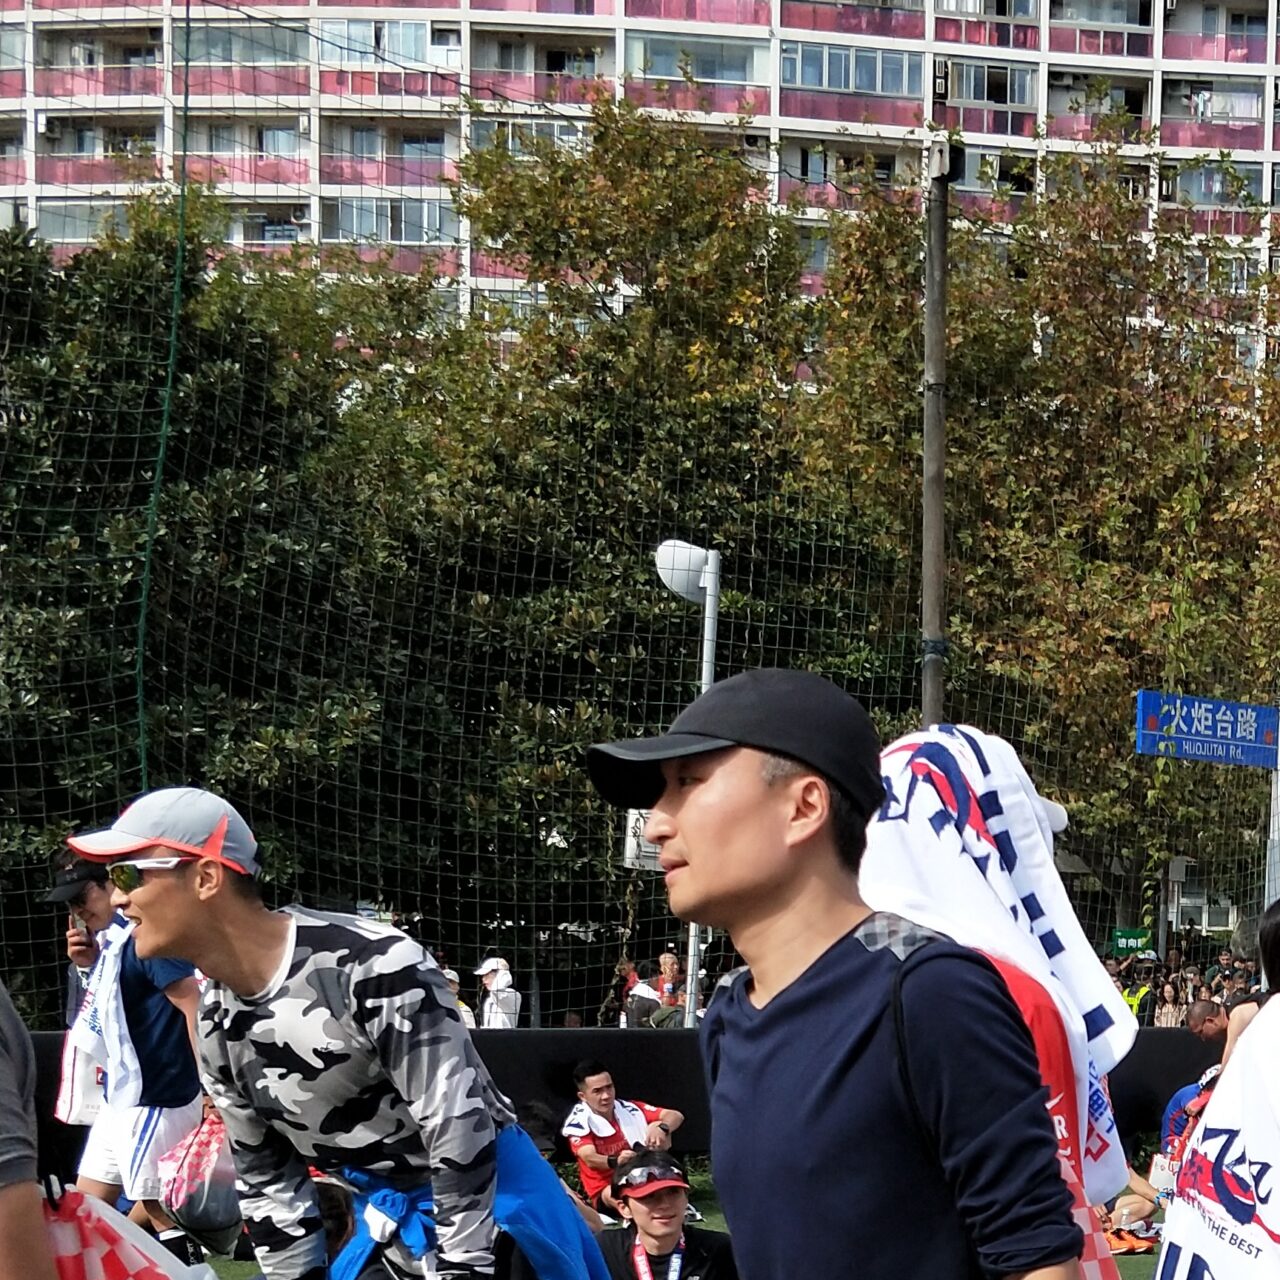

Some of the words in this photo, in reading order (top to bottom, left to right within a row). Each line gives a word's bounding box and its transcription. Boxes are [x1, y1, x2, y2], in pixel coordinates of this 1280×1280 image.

[1163, 699, 1258, 741] 火炬台路
[1182, 740, 1226, 758] HUOJUTAI
[1207, 1217, 1229, 1241] THE
[1228, 1232, 1263, 1260] BEST
